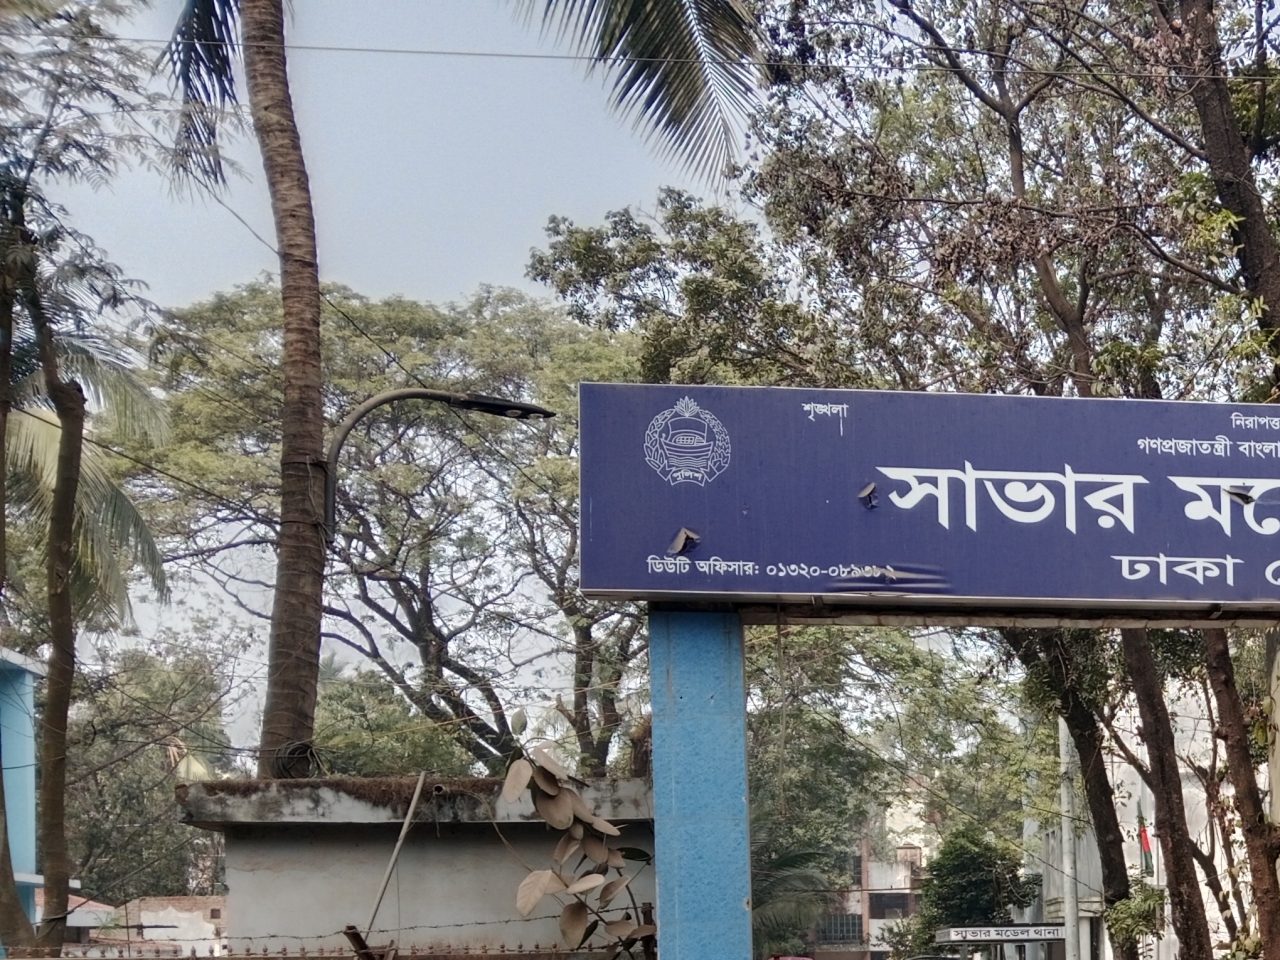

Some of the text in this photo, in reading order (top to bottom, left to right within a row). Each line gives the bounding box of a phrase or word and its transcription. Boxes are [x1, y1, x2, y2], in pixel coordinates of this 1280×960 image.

[1137, 435, 1232, 457] গণপ্রজাতন্ত্রী
[672, 469, 703, 481] পুলিশ
[875, 460, 1150, 534] সাভার
[646, 555, 691, 575] ডিউটি
[1111, 552, 1245, 587] ঢাকা
[953, 927, 1060, 940] সাভার মডেল থানা
